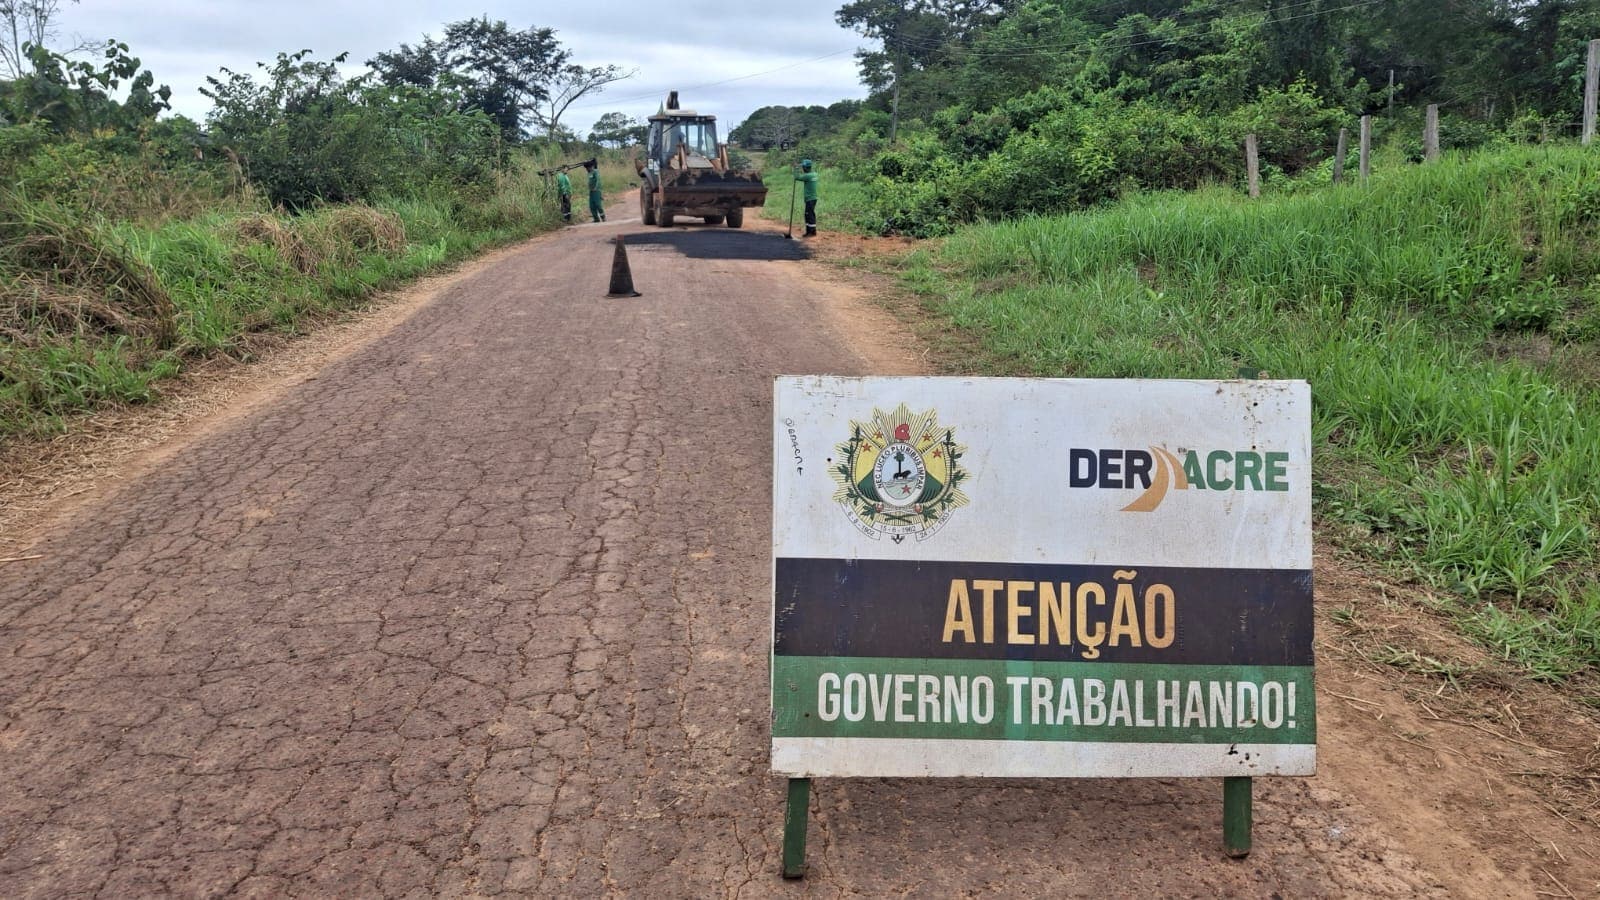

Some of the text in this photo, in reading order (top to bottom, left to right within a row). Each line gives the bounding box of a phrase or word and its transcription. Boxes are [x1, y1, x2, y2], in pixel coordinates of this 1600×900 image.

[1069, 448, 1289, 491] DER ACRE
[942, 569, 1176, 659] ATENÇÃO
[818, 672, 1296, 729] GOVERNO TRABALHANDO!
